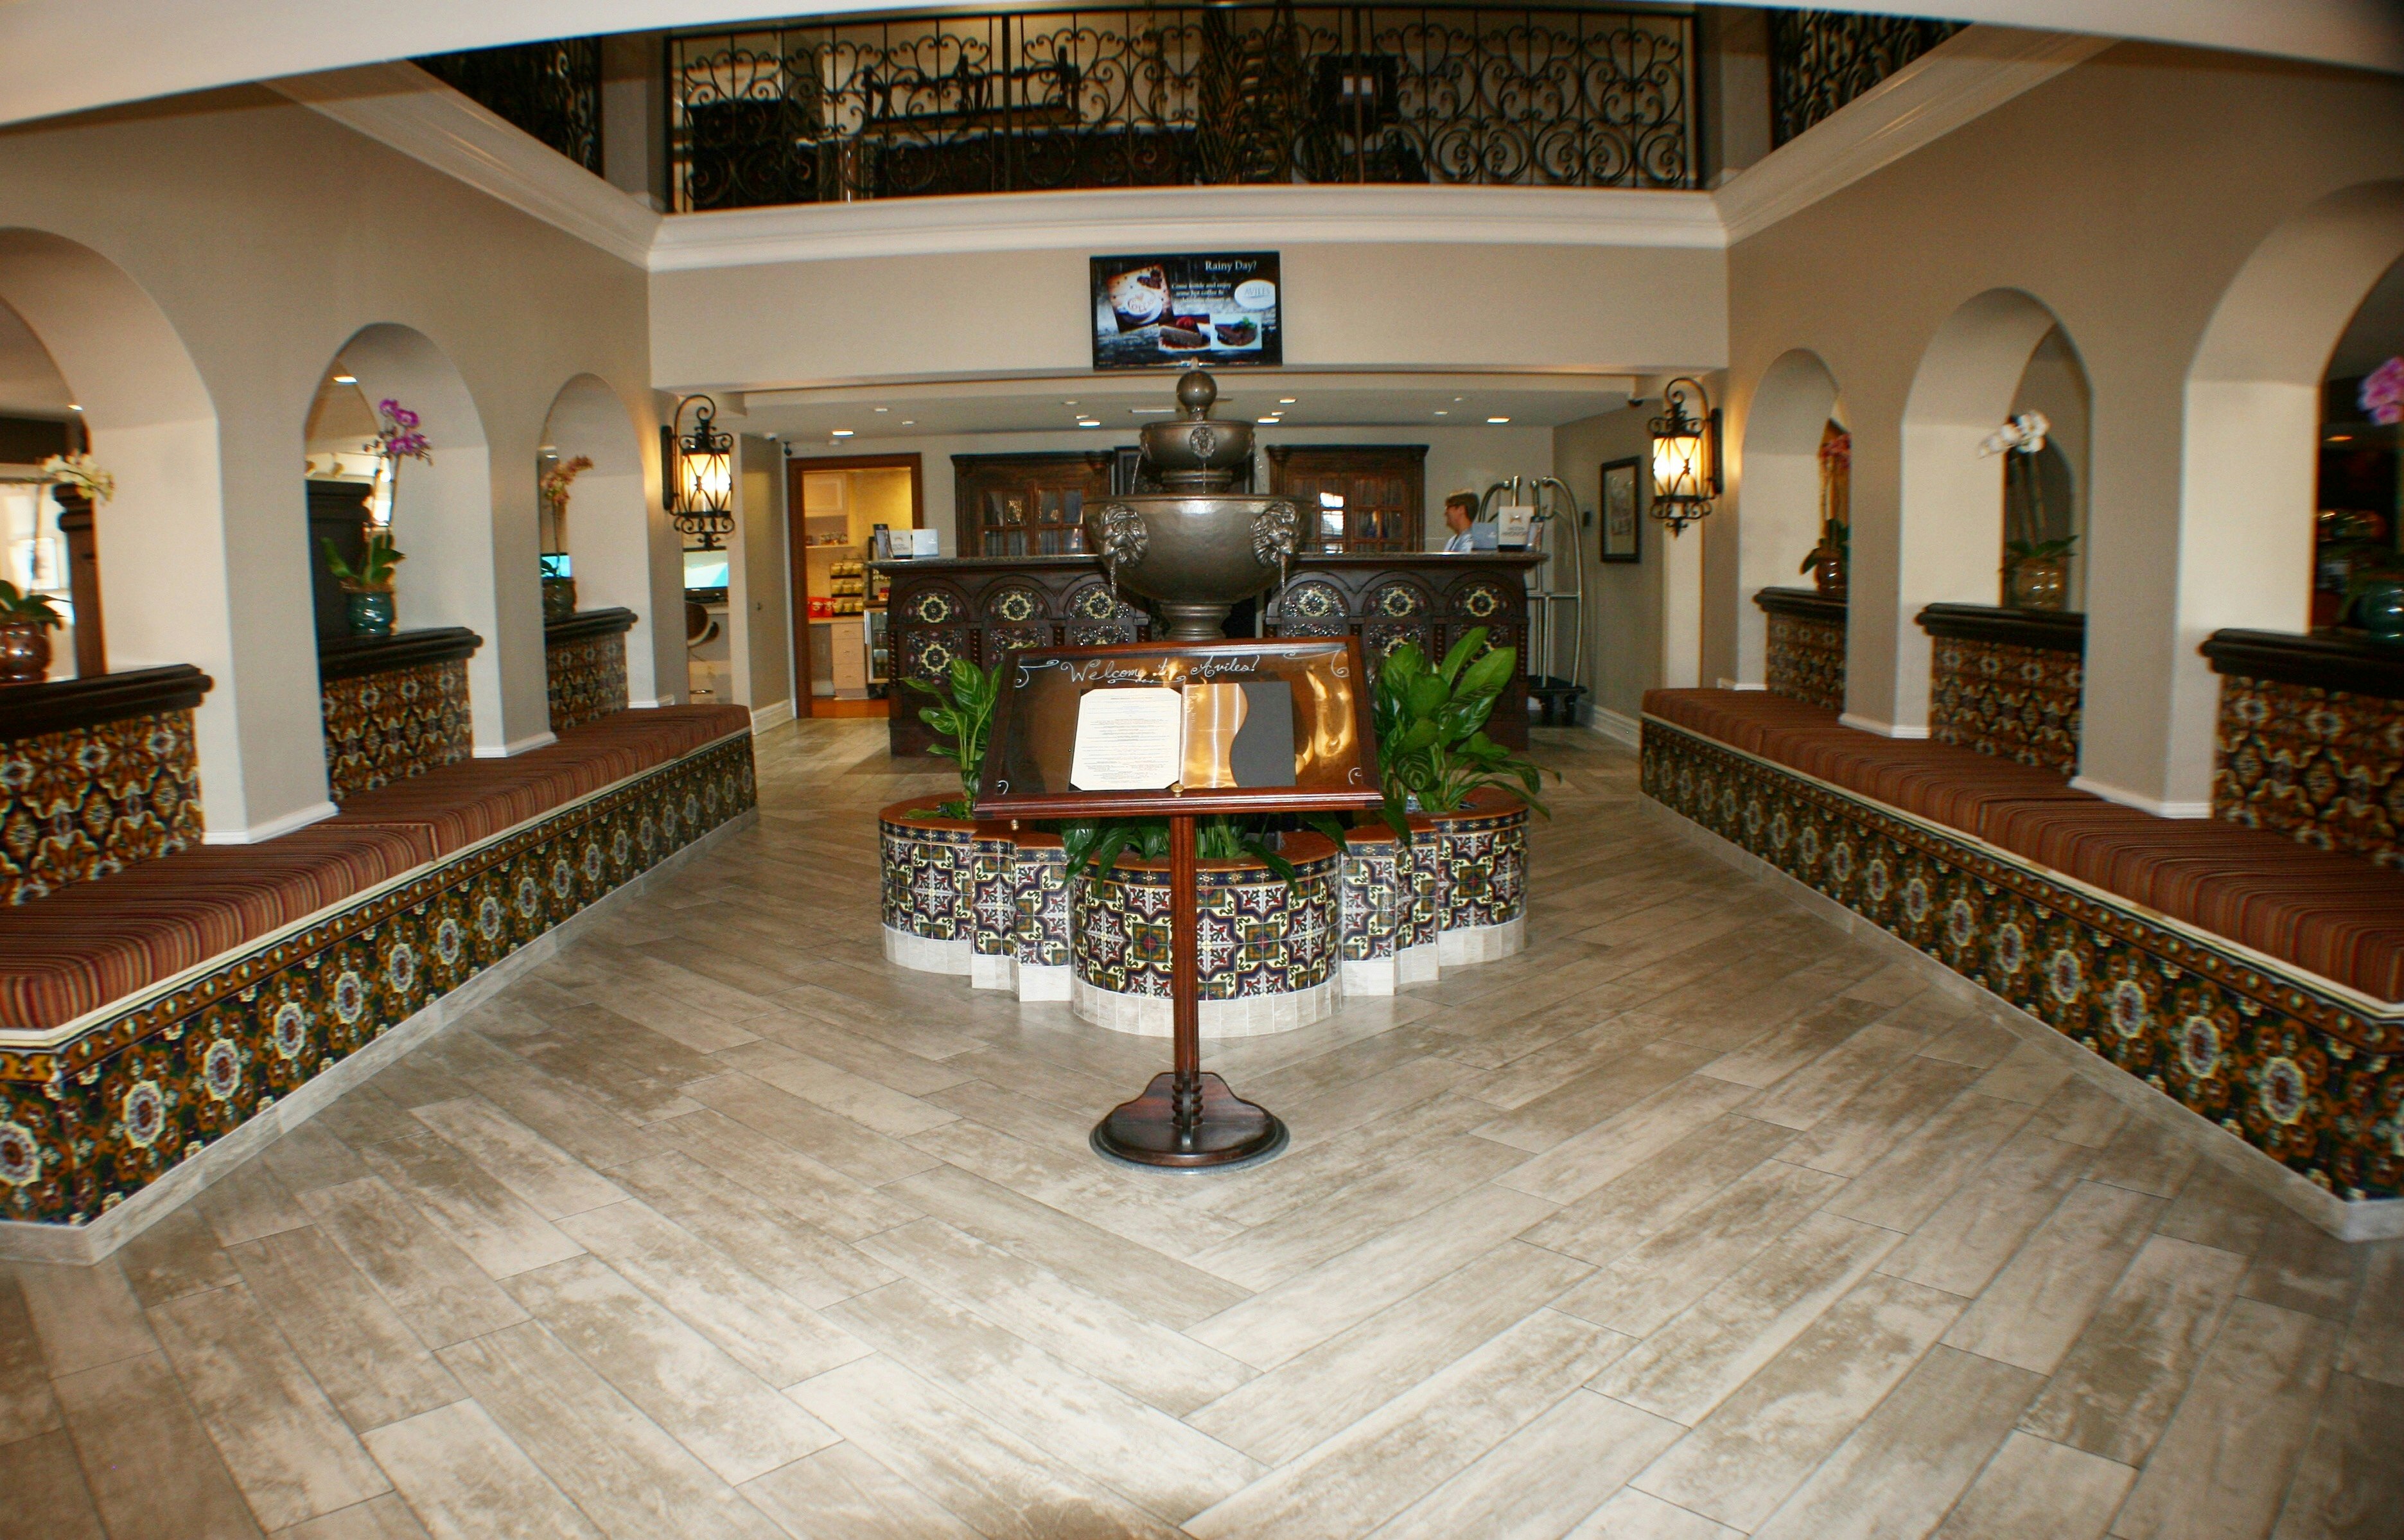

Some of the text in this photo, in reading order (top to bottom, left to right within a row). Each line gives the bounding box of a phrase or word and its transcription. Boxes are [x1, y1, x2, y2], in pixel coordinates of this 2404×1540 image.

[1205, 259, 1257, 272] Rainy Day?
[1060, 659, 1148, 683] Welcome
[1191, 655, 1259, 677] Aviles!
